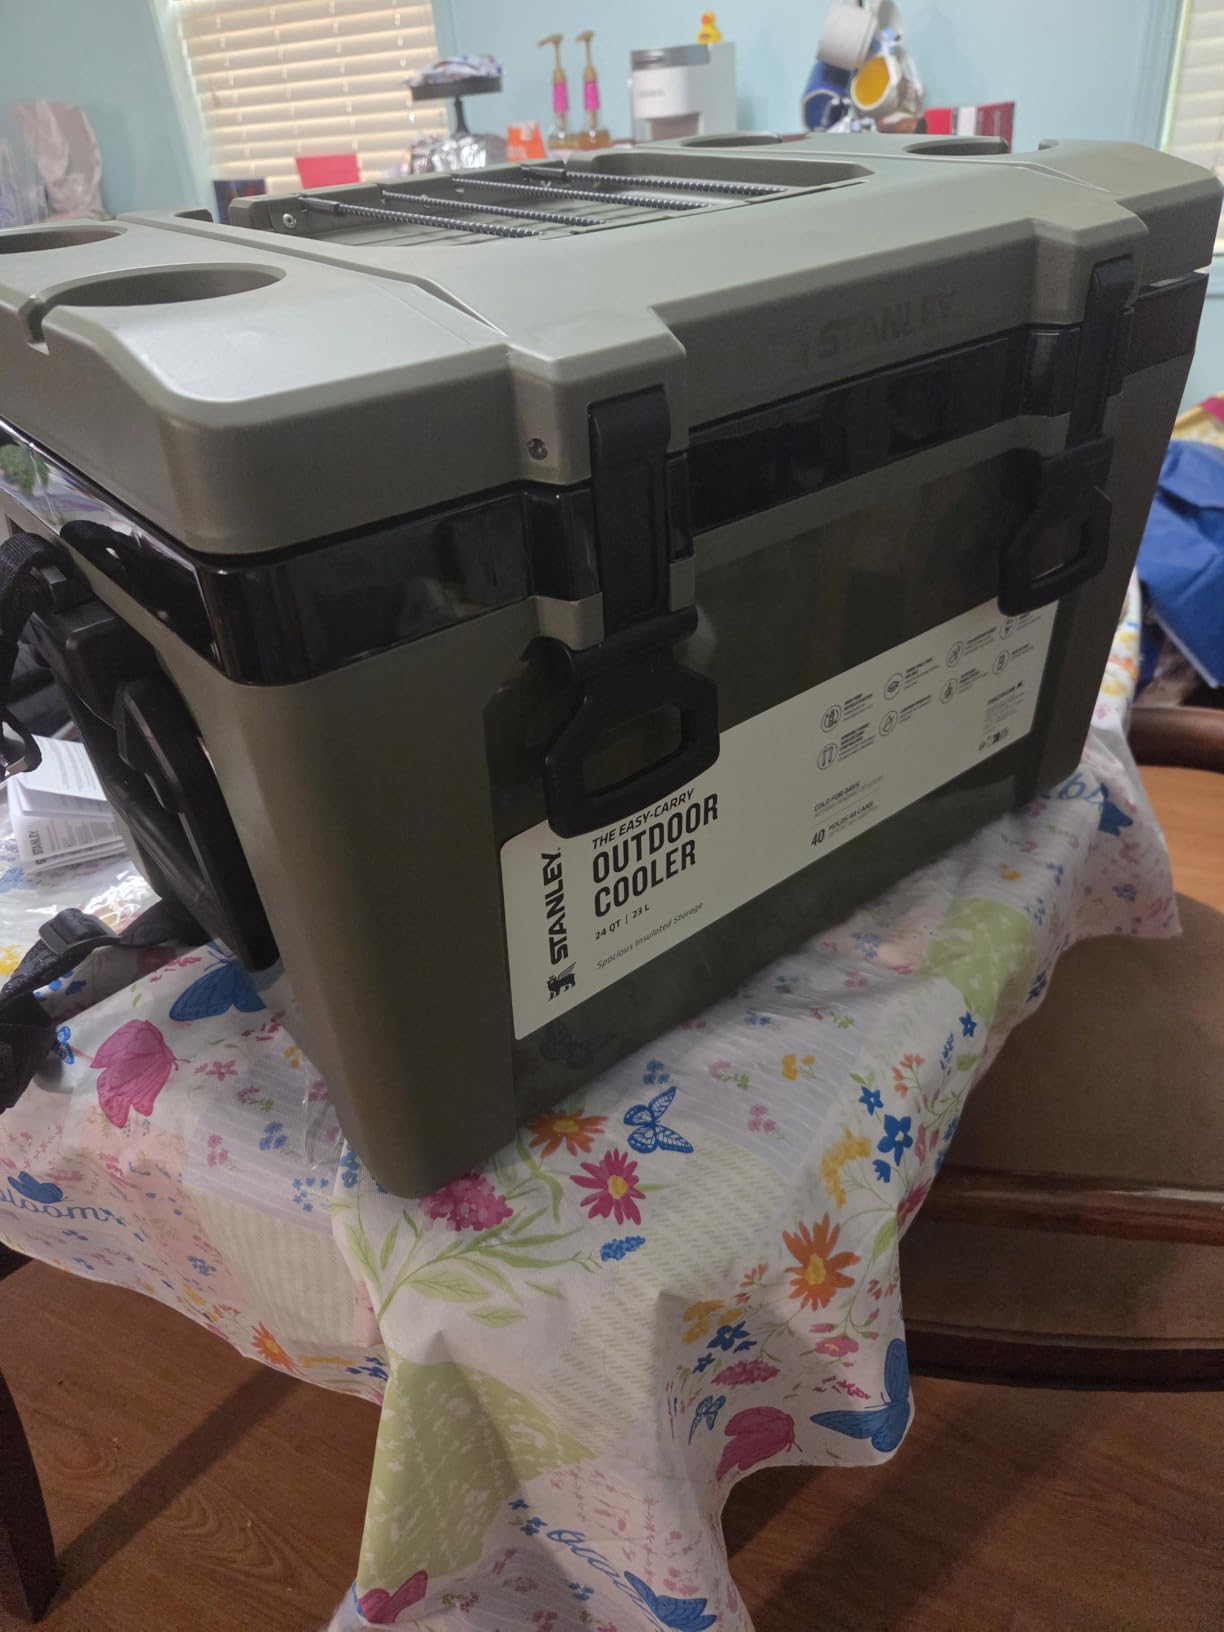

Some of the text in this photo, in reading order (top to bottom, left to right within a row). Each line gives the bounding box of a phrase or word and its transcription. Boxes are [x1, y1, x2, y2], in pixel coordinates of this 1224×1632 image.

[592, 788, 694, 849] THE EASY-CARRY
[593, 793, 719, 884] OUTDOOR
[810, 828, 825, 846] 40
[541, 852, 568, 965] STANLEY
[594, 839, 696, 918] COOLER
[595, 927, 607, 940] 24
[609, 919, 622, 932] QT
[632, 909, 643, 919] 23
[596, 901, 704, 970] Spacious Insulated Storage
